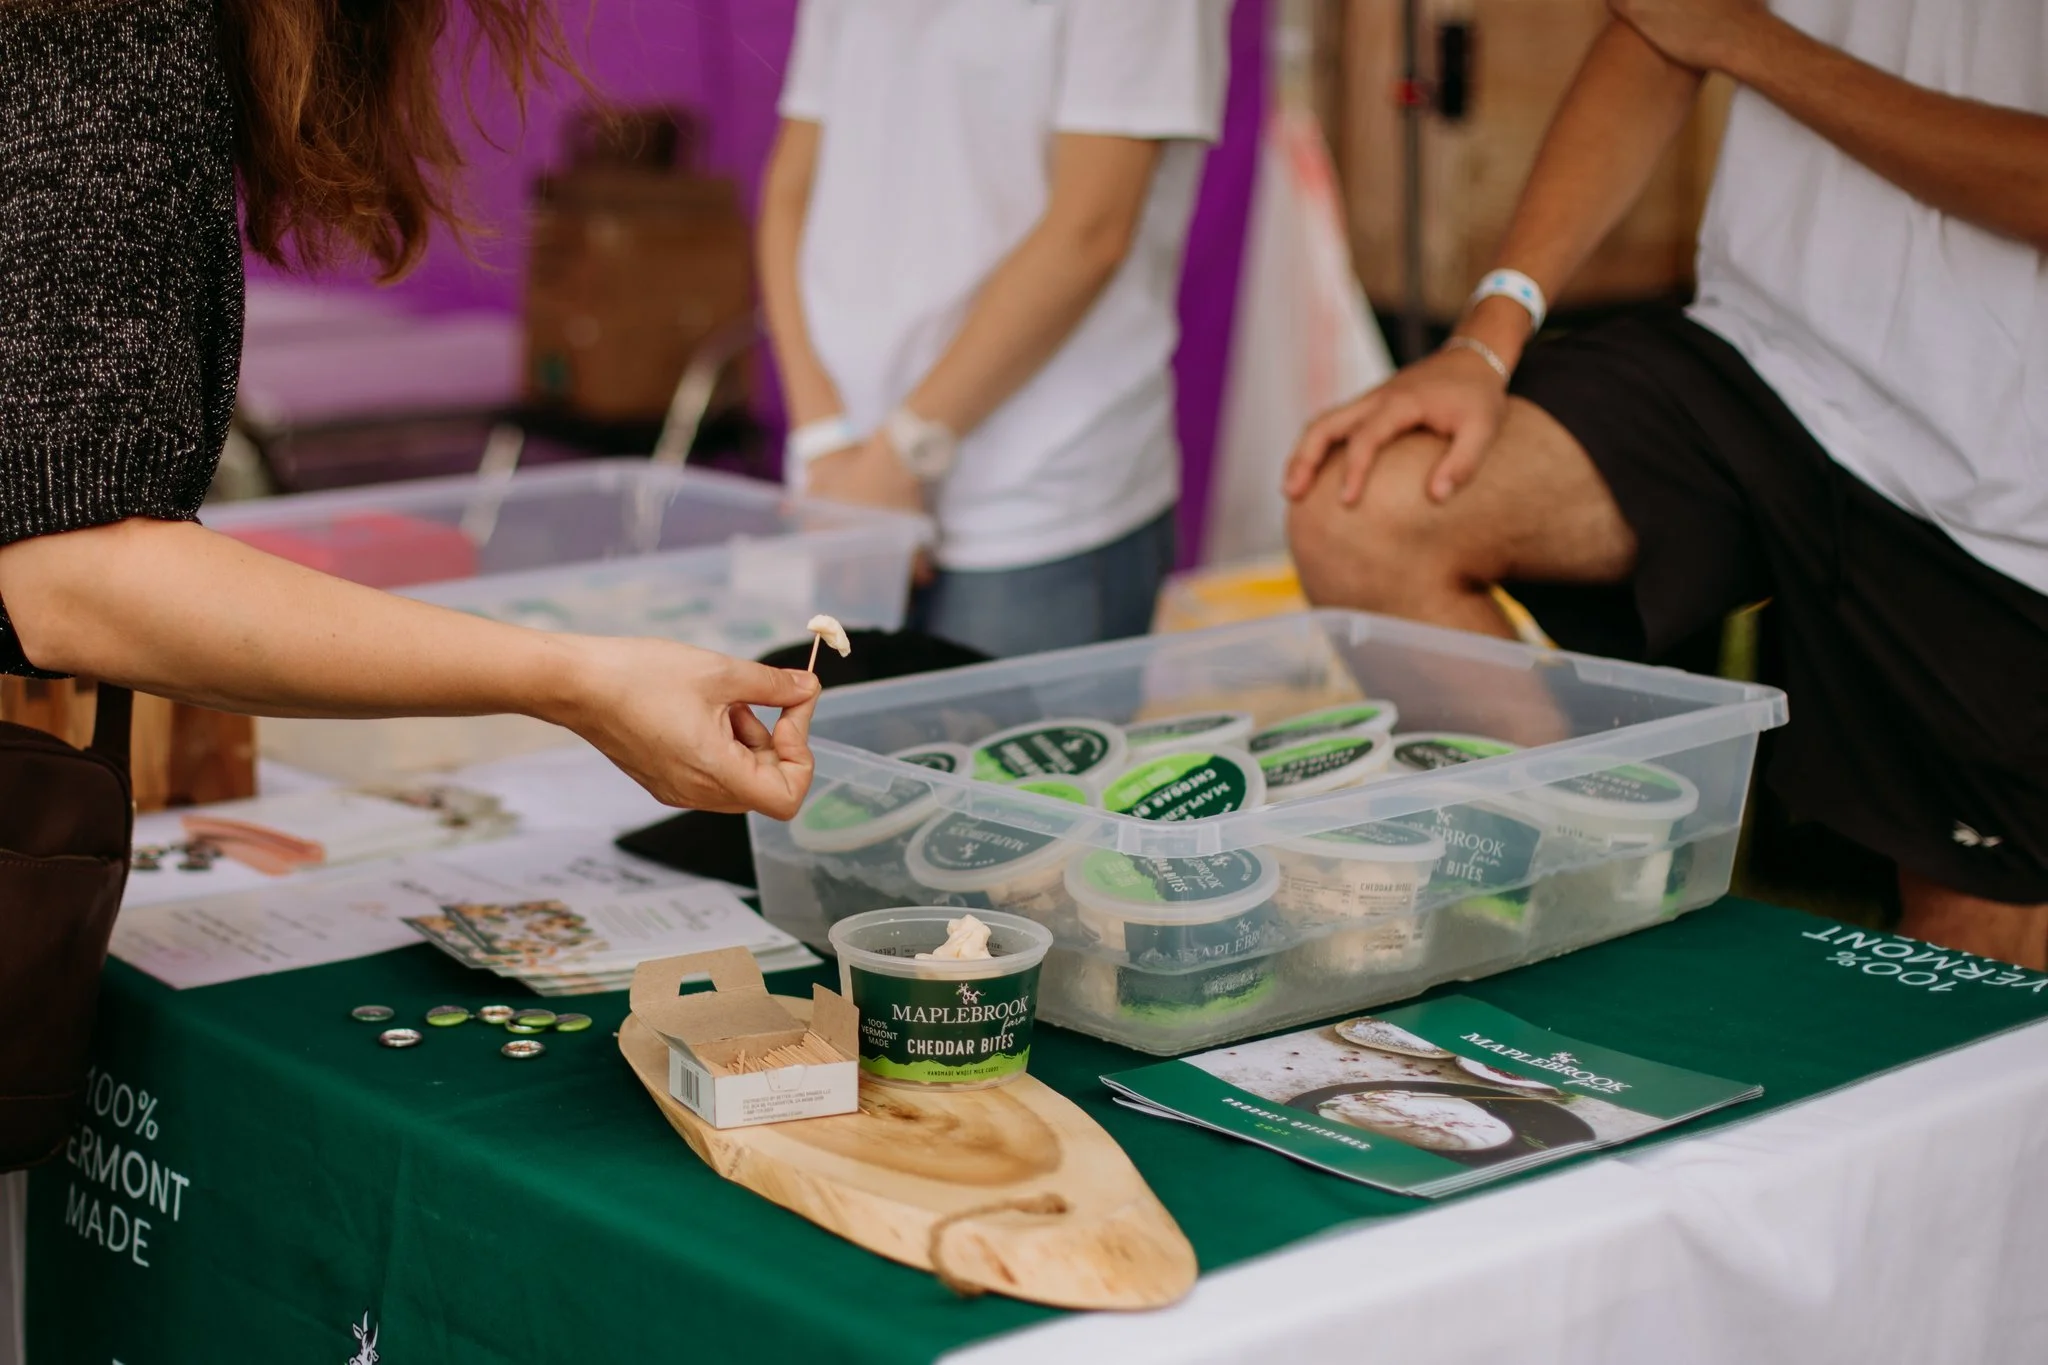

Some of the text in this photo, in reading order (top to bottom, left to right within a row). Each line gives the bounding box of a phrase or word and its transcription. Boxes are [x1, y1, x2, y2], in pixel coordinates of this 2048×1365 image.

[1446, 861, 1484, 881] BITES
[1359, 882, 1393, 893] CHEDDAR
[1801, 925, 2048, 993] VERMONT
[1826, 950, 1958, 992] 100%
[866, 1017, 888, 1030] 100%
[891, 996, 1029, 1025] MAPLEBROOK
[861, 1024, 898, 1041] VERMONT
[1001, 1014, 1028, 1036] farm
[867, 1035, 890, 1049] MADE
[907, 1032, 1014, 1056] CHEDDAR BITES
[1459, 1032, 1632, 1092] MAPLEBROOK
[1563, 1079, 1615, 1094] farm
[86, 1065, 159, 1141] 100%
[1222, 1097, 1372, 1151] PRODUCT OFFERINGS
[66, 1124, 190, 1222] ERMONT
[65, 1182, 152, 1268] MADE
